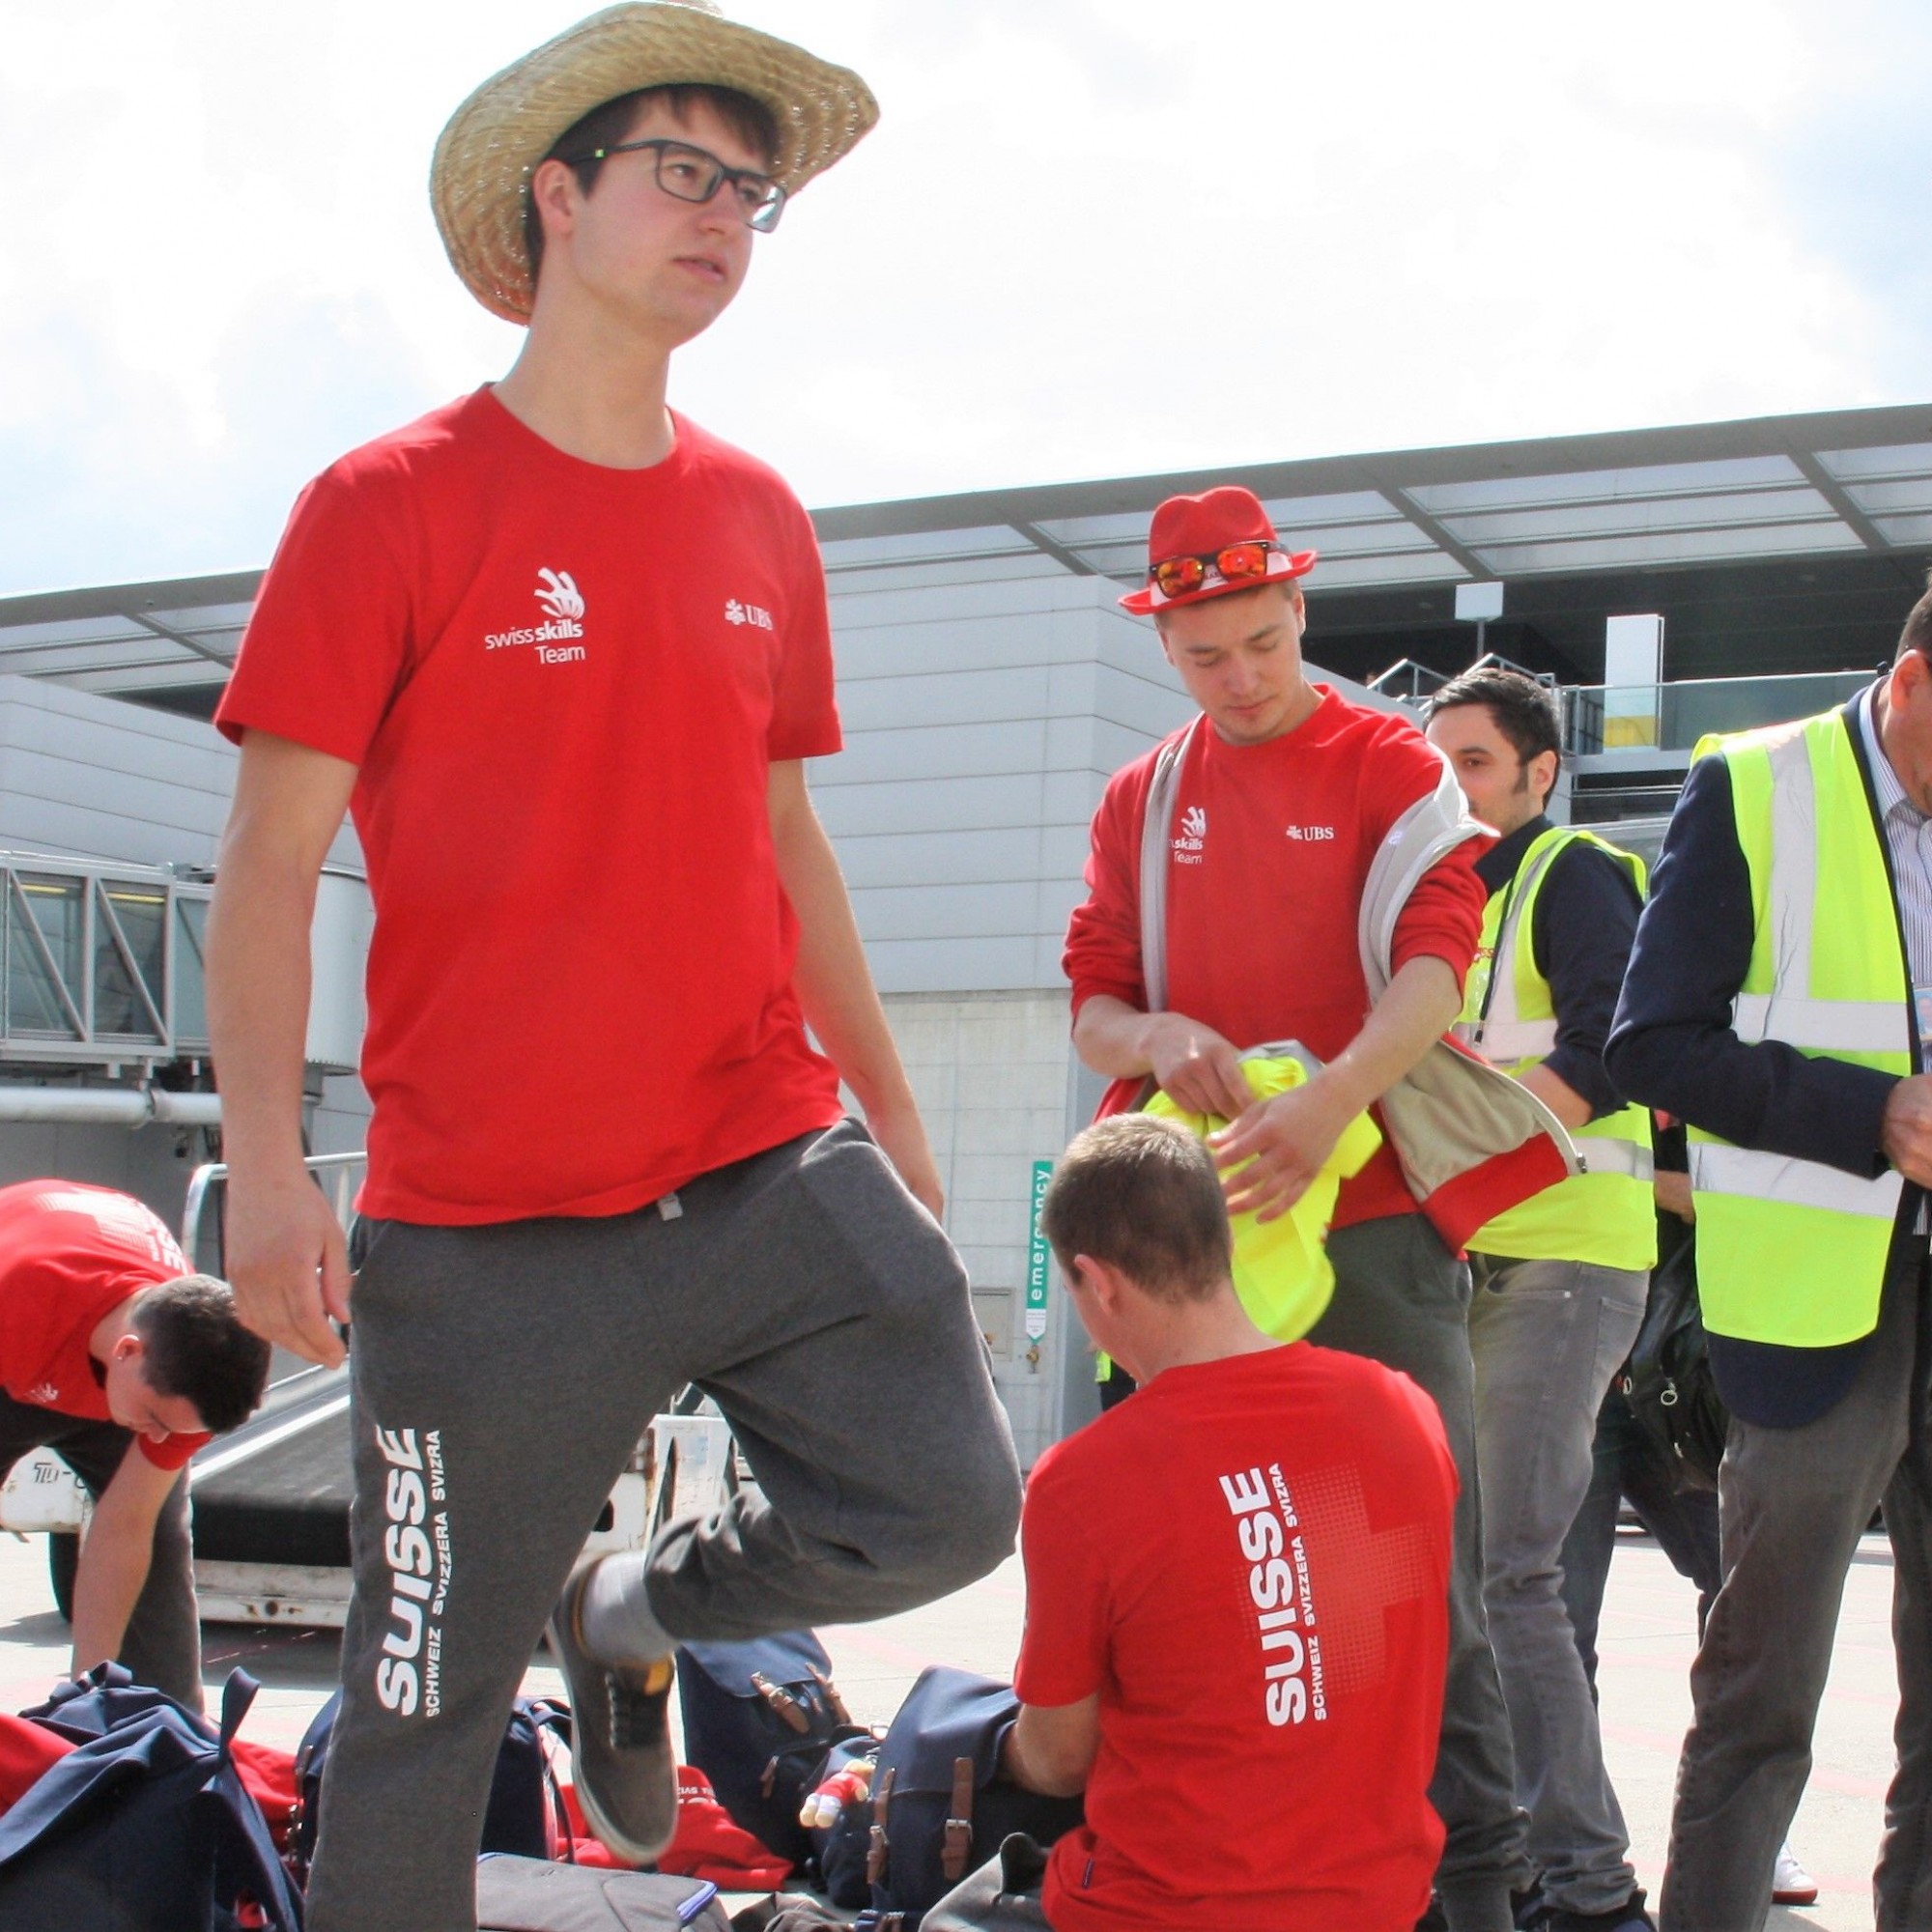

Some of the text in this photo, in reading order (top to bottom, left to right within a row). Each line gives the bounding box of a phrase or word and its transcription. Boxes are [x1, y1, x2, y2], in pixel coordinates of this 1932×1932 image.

[535, 645, 585, 665] Team
[745, 604, 773, 631] UBS
[1174, 851, 1203, 865] Team
[1304, 827, 1335, 841] UBS
[376, 1424, 433, 1717] SUISSE
[426, 1430, 452, 1718] SCHWEIZ SVIZZERA SVIZRA
[1219, 1467, 1307, 1727] SUISSE
[1268, 1463, 1326, 1721] SCHWEIZ SVIZZERA SVIZRA
